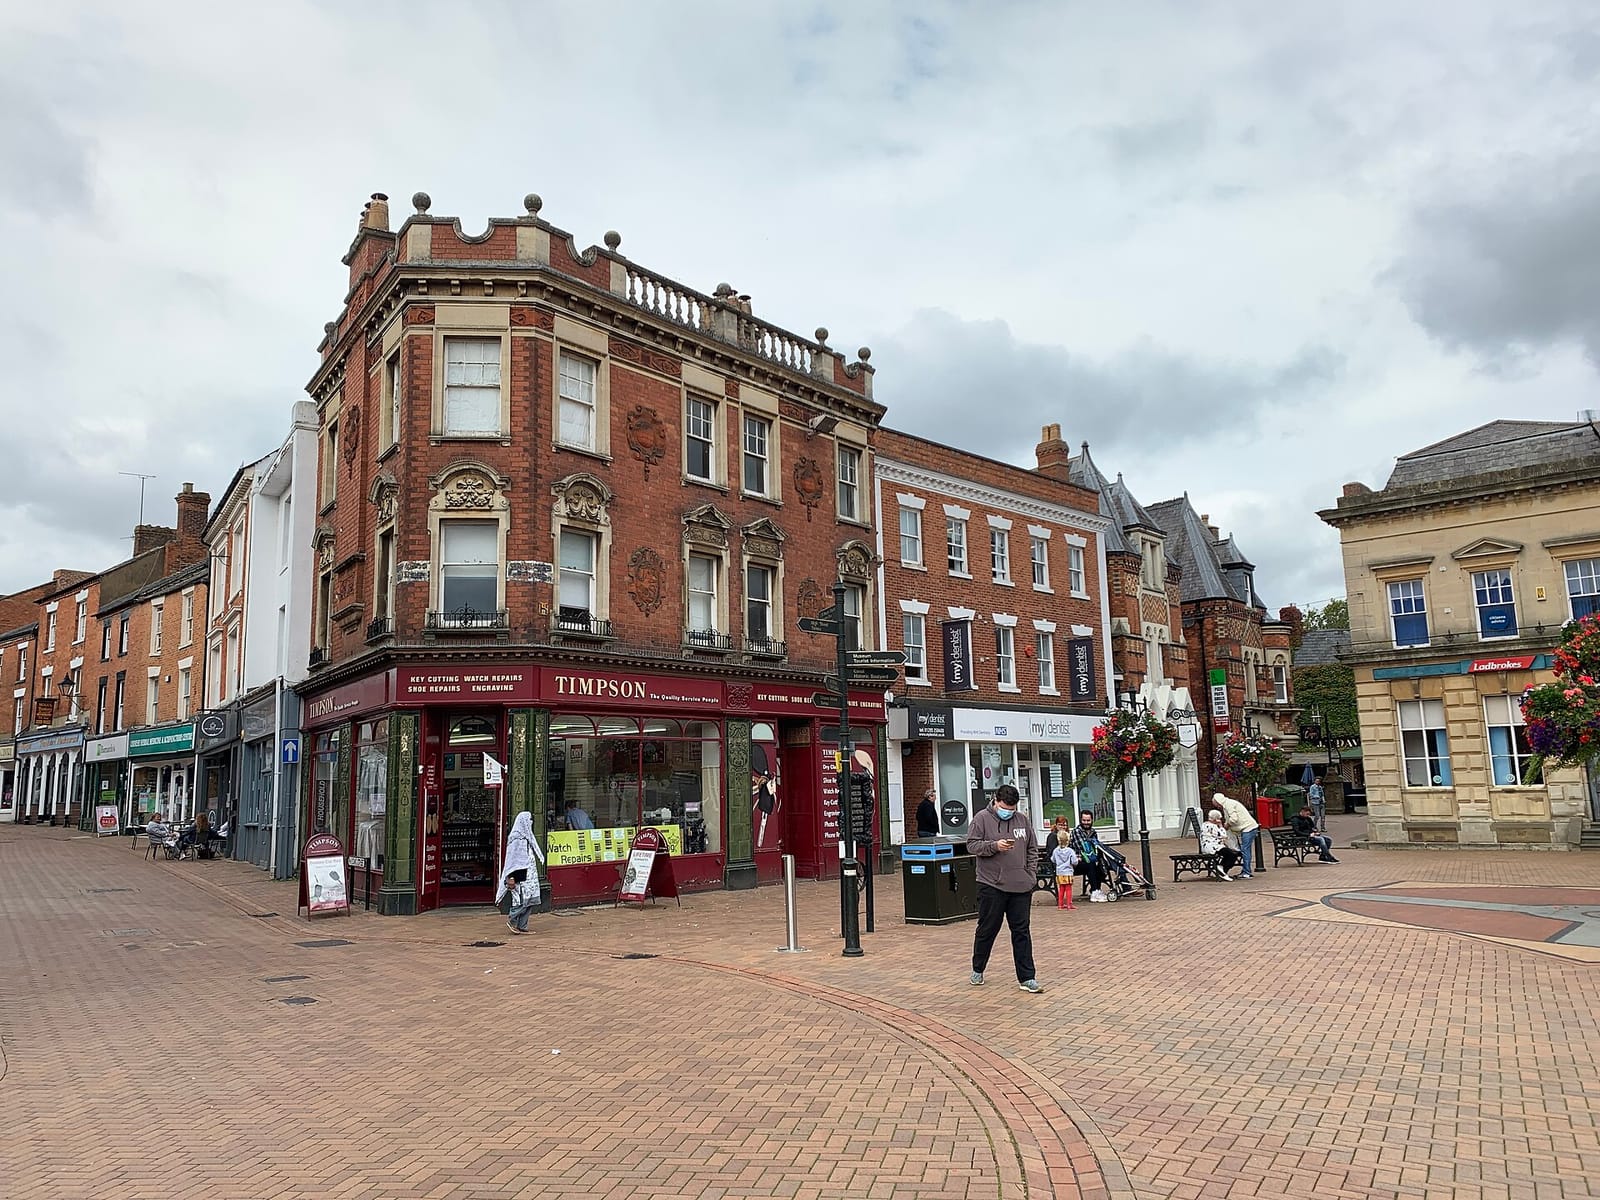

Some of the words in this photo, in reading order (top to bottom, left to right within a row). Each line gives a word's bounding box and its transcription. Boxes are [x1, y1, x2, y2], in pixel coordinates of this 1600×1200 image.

[1473, 660, 1522, 671] Ladbrokes
[407, 685, 427, 693] SHOE
[471, 684, 514, 692] ENGRAVING
[555, 676, 647, 698] TIMPSON
[661, 694, 681, 702] Quality
[757, 693, 768, 701] KEY
[309, 695, 335, 719] TIMPSON
[995, 727, 1007, 735] NHS
[317, 780, 326, 821] HOUSEHOLD
[637, 832, 657, 843] TIMPSON
[308, 838, 340, 851] TIMPSON
[547, 842, 572, 853] Watch
[561, 854, 592, 865] Repairs
